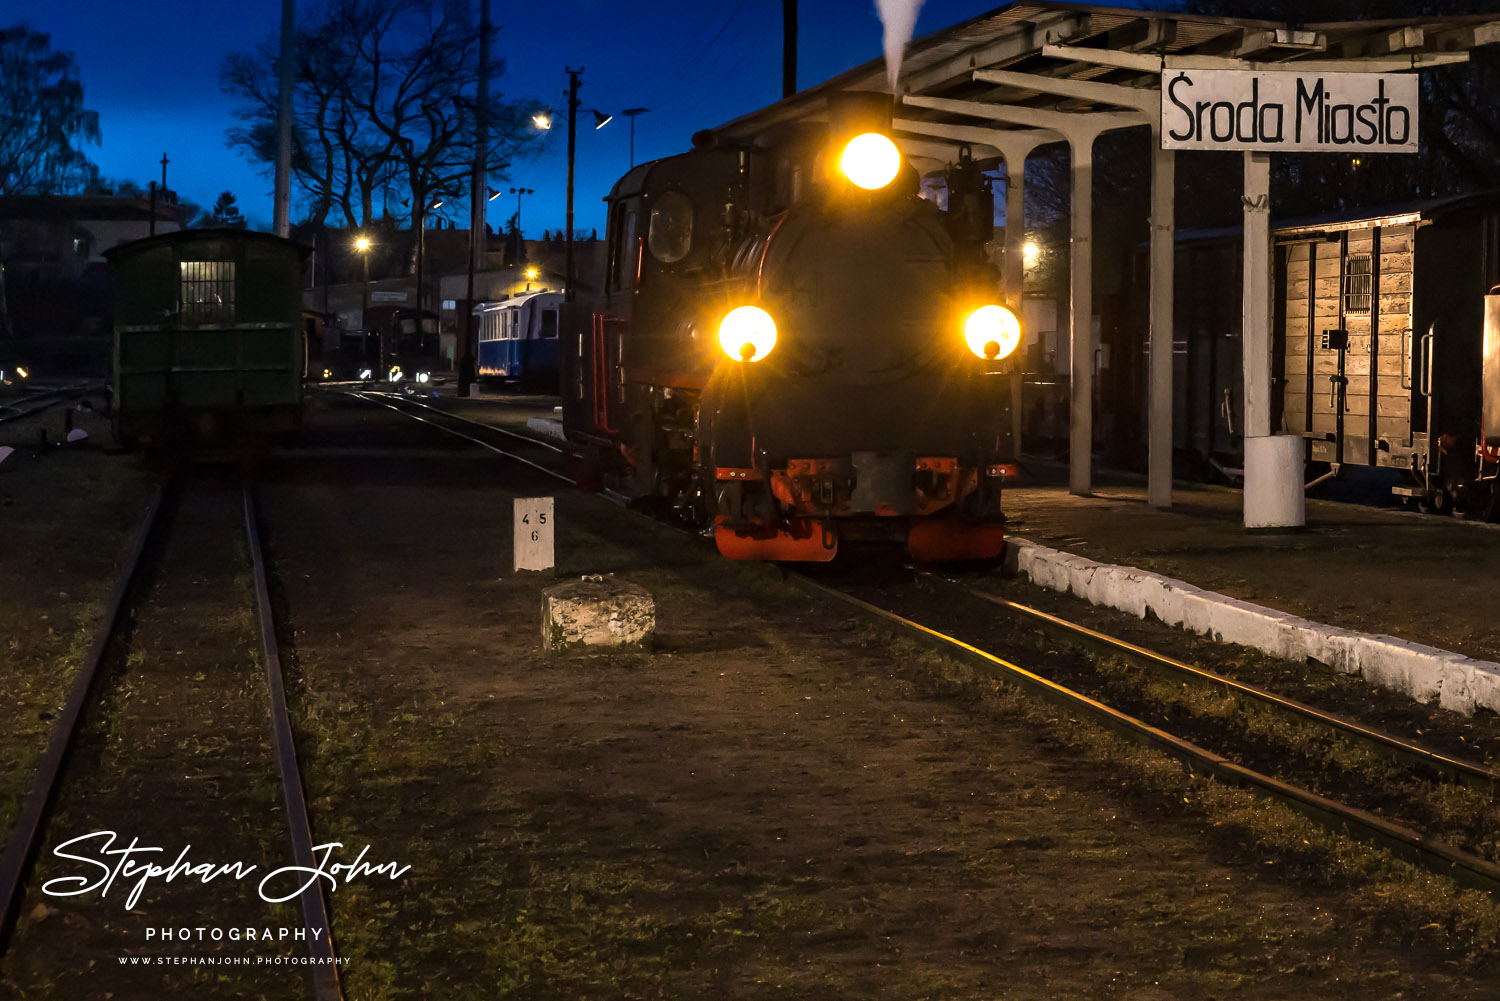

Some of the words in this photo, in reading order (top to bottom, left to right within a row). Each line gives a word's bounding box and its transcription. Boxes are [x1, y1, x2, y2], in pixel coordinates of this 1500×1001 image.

[1168, 71, 1285, 142] Środa
[1295, 77, 1410, 145] Miasto
[522, 513, 529, 525] 4
[539, 513, 547, 525] 5
[531, 530, 539, 541] 6
